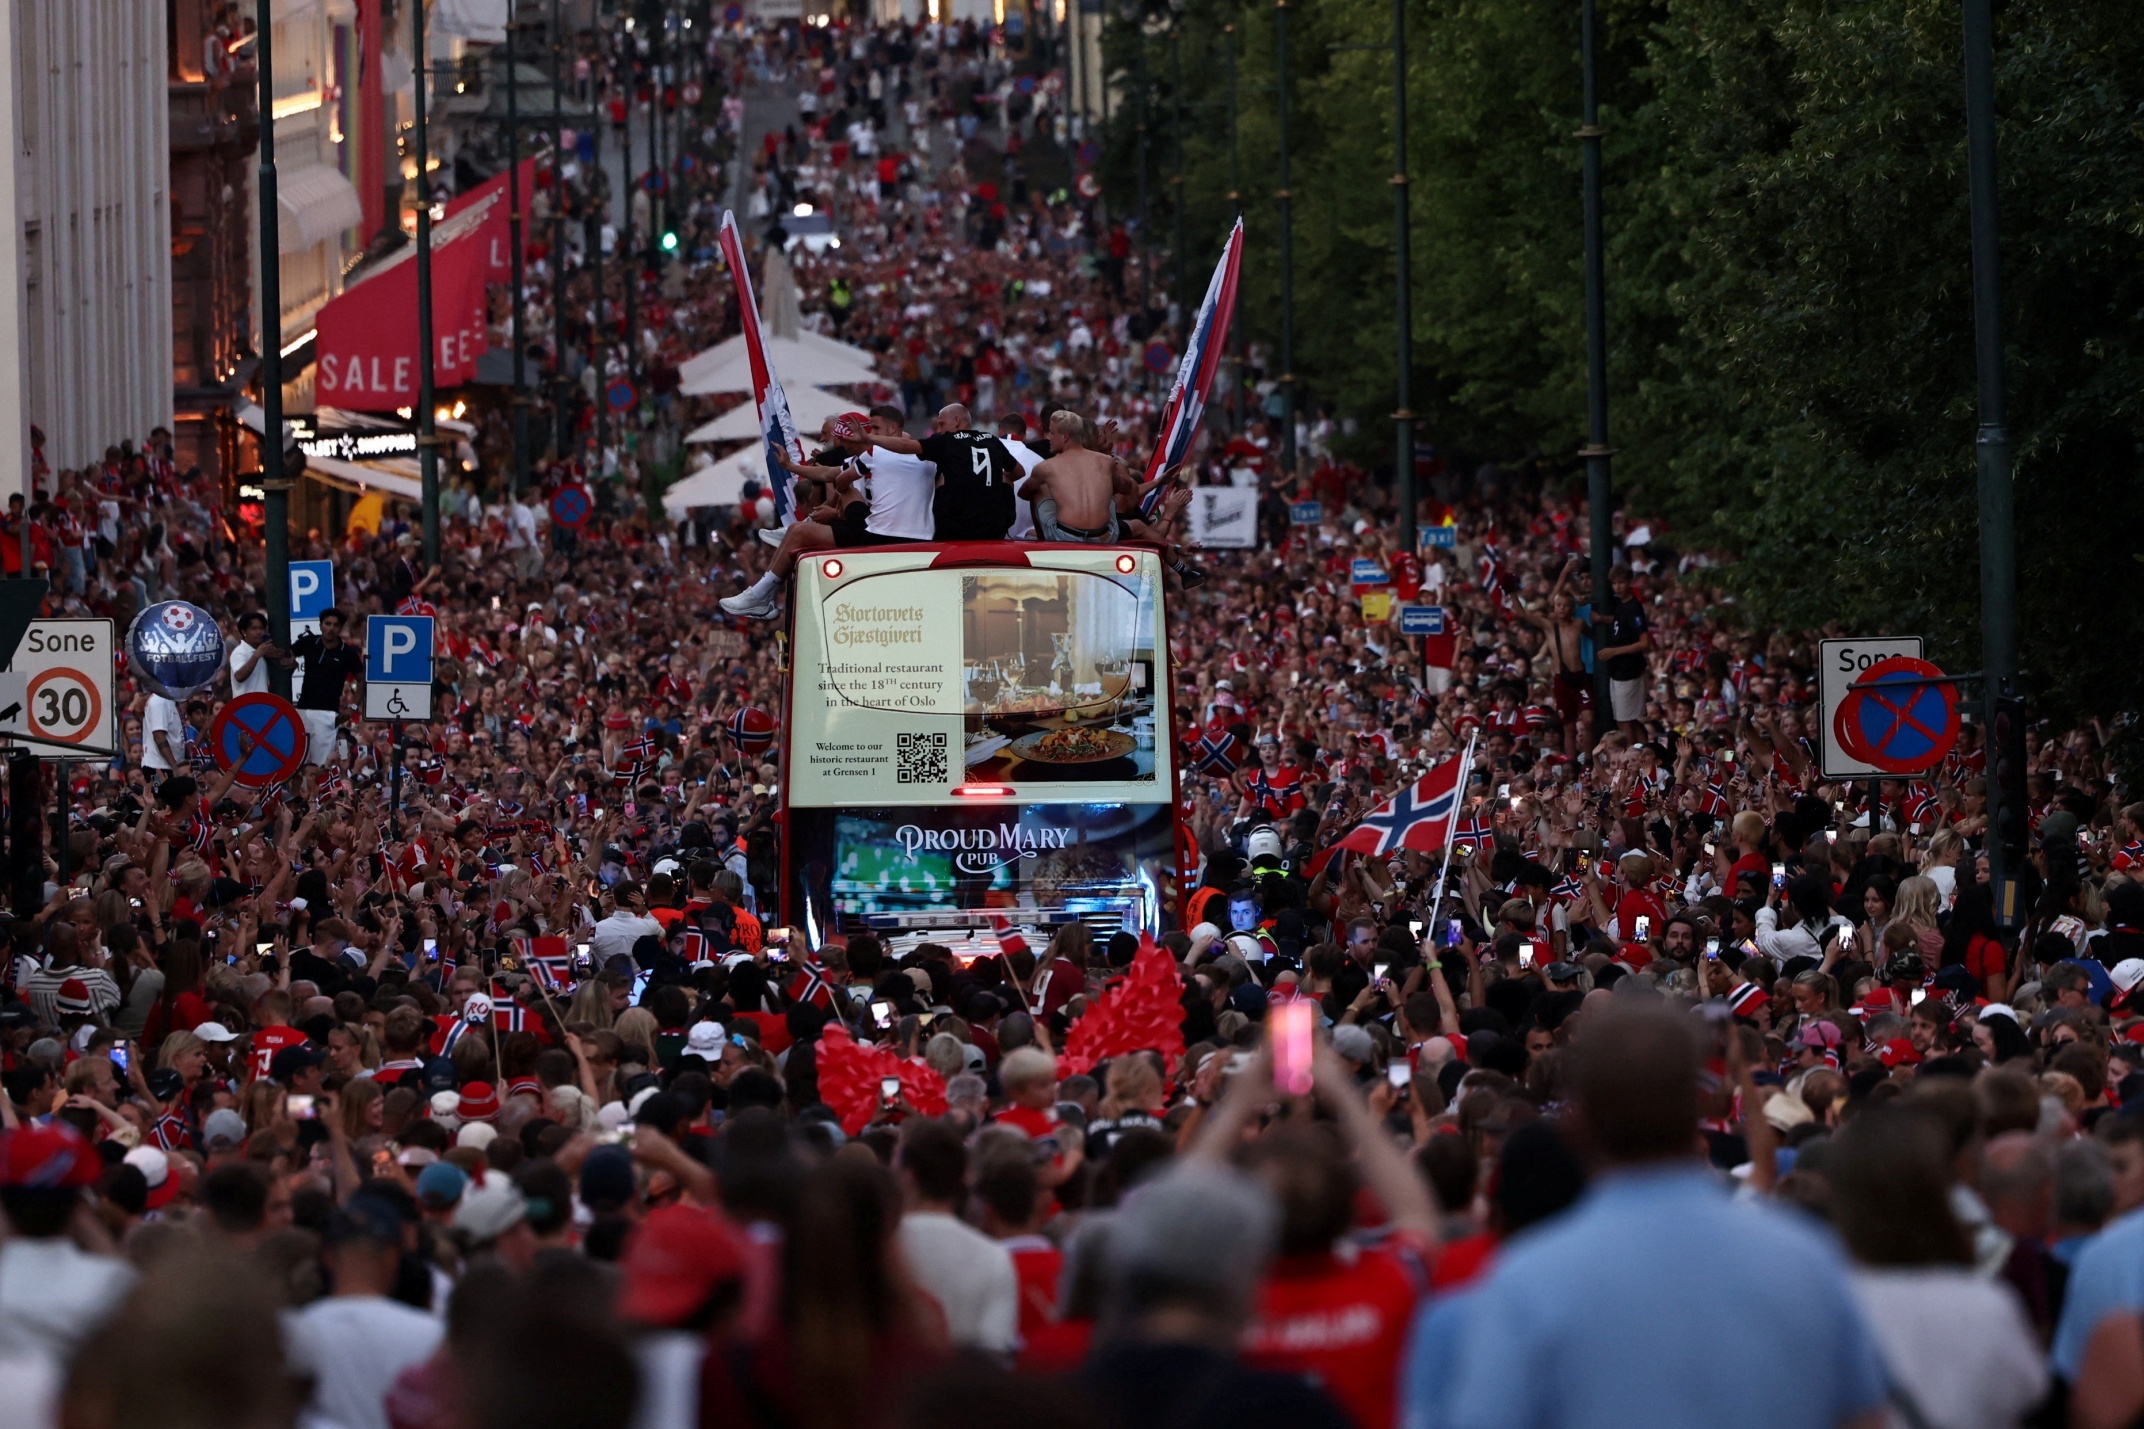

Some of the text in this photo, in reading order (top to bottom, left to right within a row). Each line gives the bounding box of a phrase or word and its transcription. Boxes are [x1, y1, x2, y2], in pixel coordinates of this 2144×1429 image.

[321, 353, 411, 392] SALE
[970, 446, 992, 487] 9
[1421, 531, 1450, 546] Taxi
[290, 569, 319, 613] P
[833, 602, 924, 624] Stortorvets
[28, 629, 95, 653] Sone
[833, 625, 922, 648] Gjæstgiveri
[146, 652, 217, 664] FOTBALLFEST
[383, 624, 417, 674] P
[1839, 648, 1903, 672] So
[817, 662, 943, 674] Traditional restaurant
[818, 678, 943, 692] since the 18TH century
[37, 688, 88, 727] 30
[825, 695, 936, 707] in the heart of Oslo
[815, 742, 854, 751] Welcome
[856, 743, 866, 751] to
[810, 755, 889, 764] historic restaurant
[822, 768, 877, 777] at Grensen 1
[967, 852, 999, 866] PUB
[1029, 969, 1053, 1015] 9
